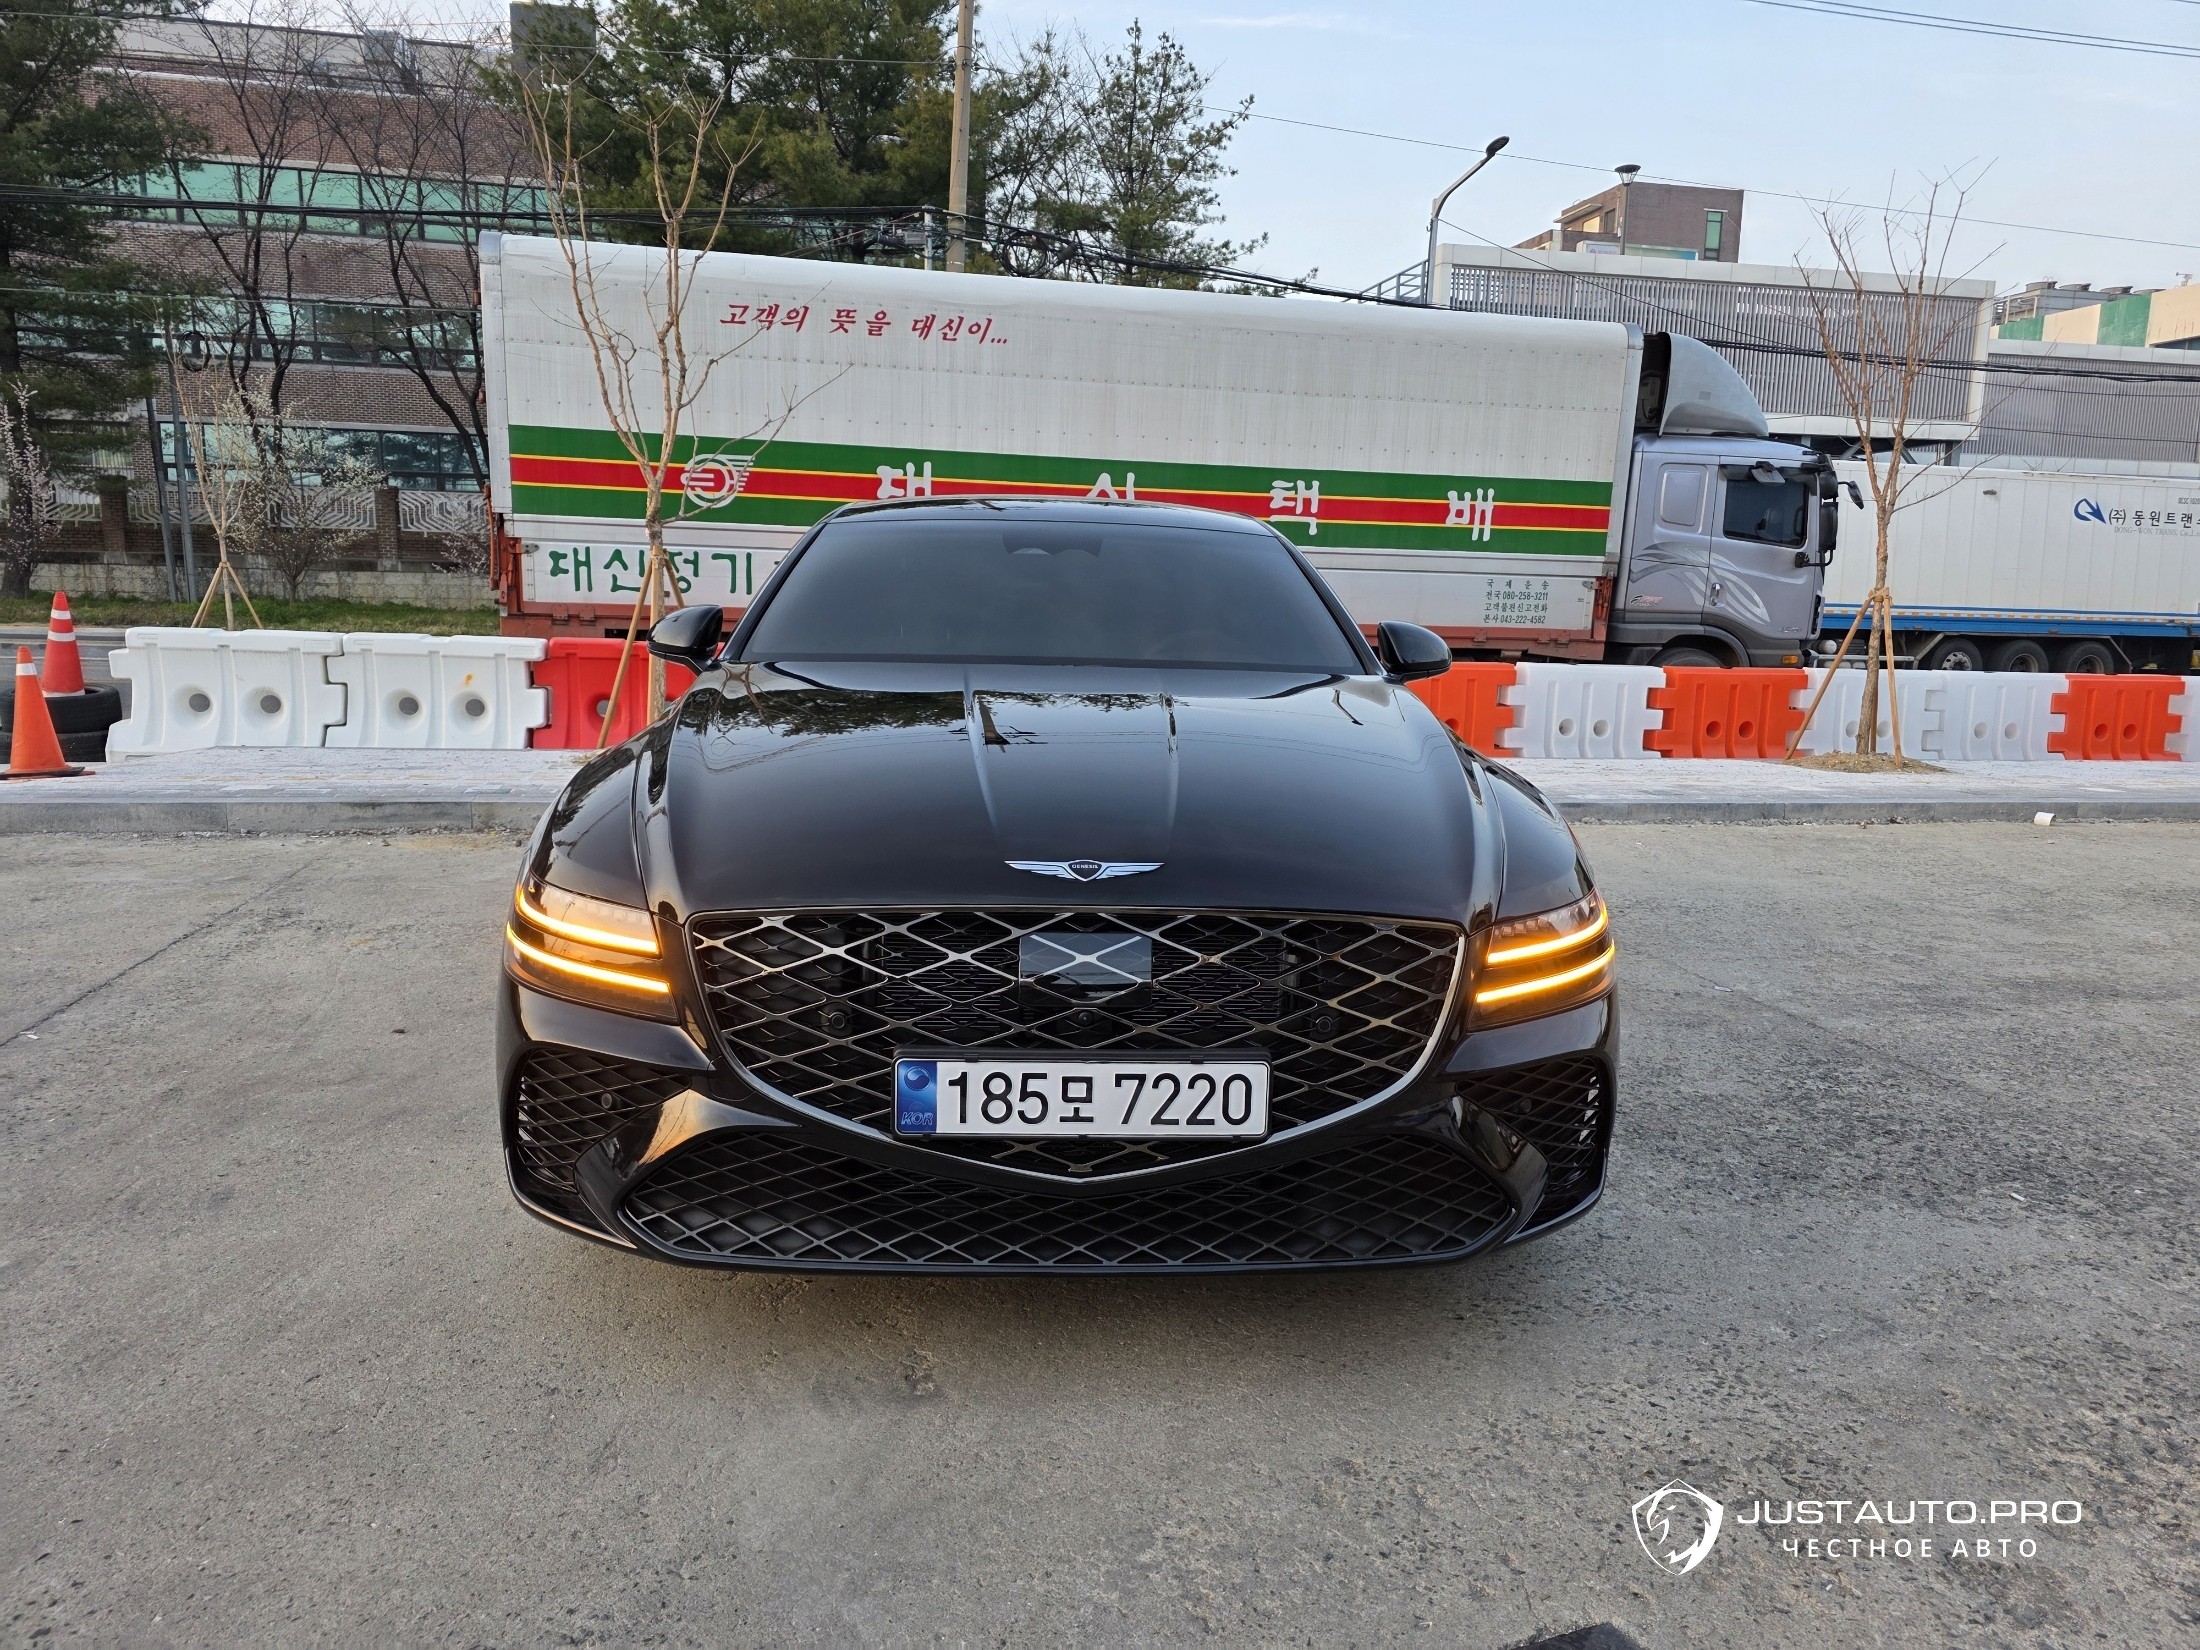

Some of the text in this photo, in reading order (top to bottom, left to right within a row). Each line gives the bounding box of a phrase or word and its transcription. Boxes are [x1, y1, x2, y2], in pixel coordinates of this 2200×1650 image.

[720, 303, 809, 333] 고객의
[829, 307, 891, 337] 뜻을
[2132, 510, 2200, 529] 동원트랜
[1485, 590, 1549, 601] 전국 080-258-3211
[1483, 613, 1499, 624] 본사
[947, 1071, 1252, 1126] 185모 7220
[901, 1111, 934, 1126] KOR
